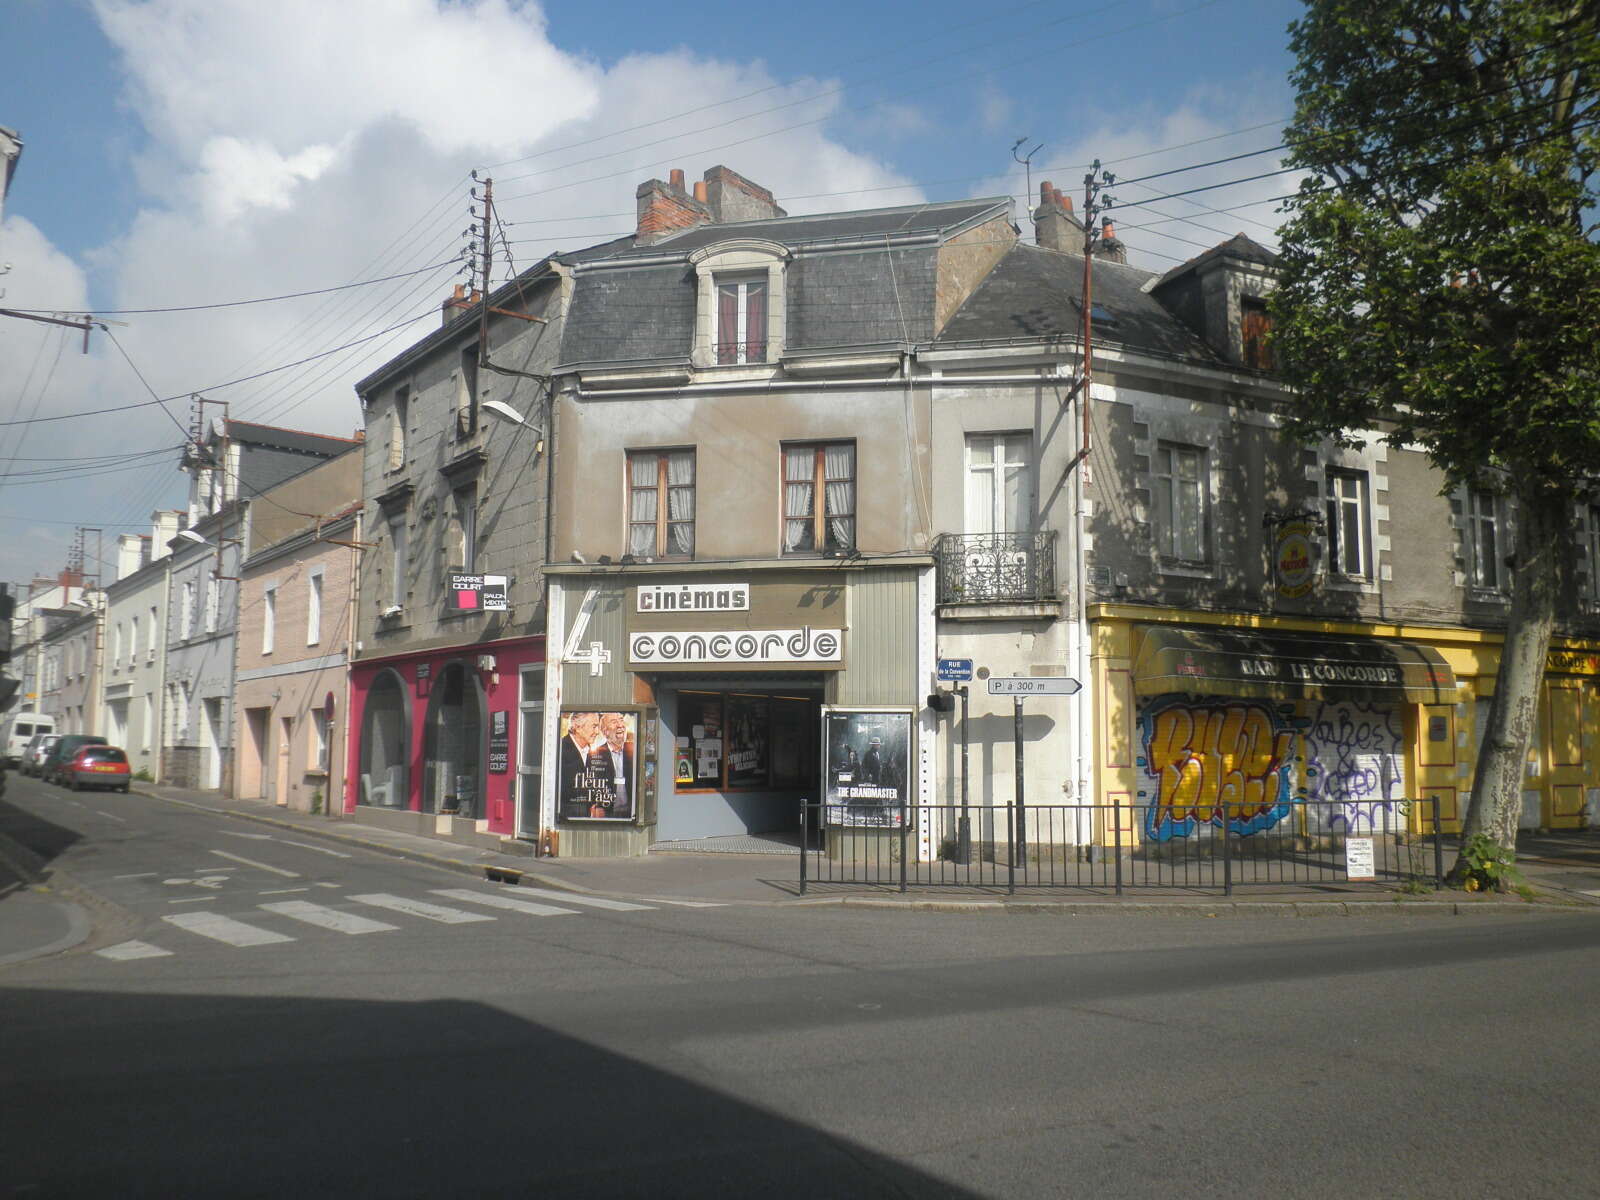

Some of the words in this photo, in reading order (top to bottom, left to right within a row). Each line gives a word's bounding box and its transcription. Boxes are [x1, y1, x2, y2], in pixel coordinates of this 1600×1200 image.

[640, 586, 745, 609] cinémas
[560, 586, 611, 677] 4
[632, 626, 838, 659] concorde
[1240, 660, 1277, 676] BAR
[1290, 663, 1311, 679] LE
[1313, 665, 1398, 682] CONCORDE
[1017, 682, 1033, 690] 300
[573, 772, 609, 789] fleur
[586, 767, 596, 779] la
[838, 787, 849, 798] THE
[849, 788, 898, 799] GRANDMASTER
